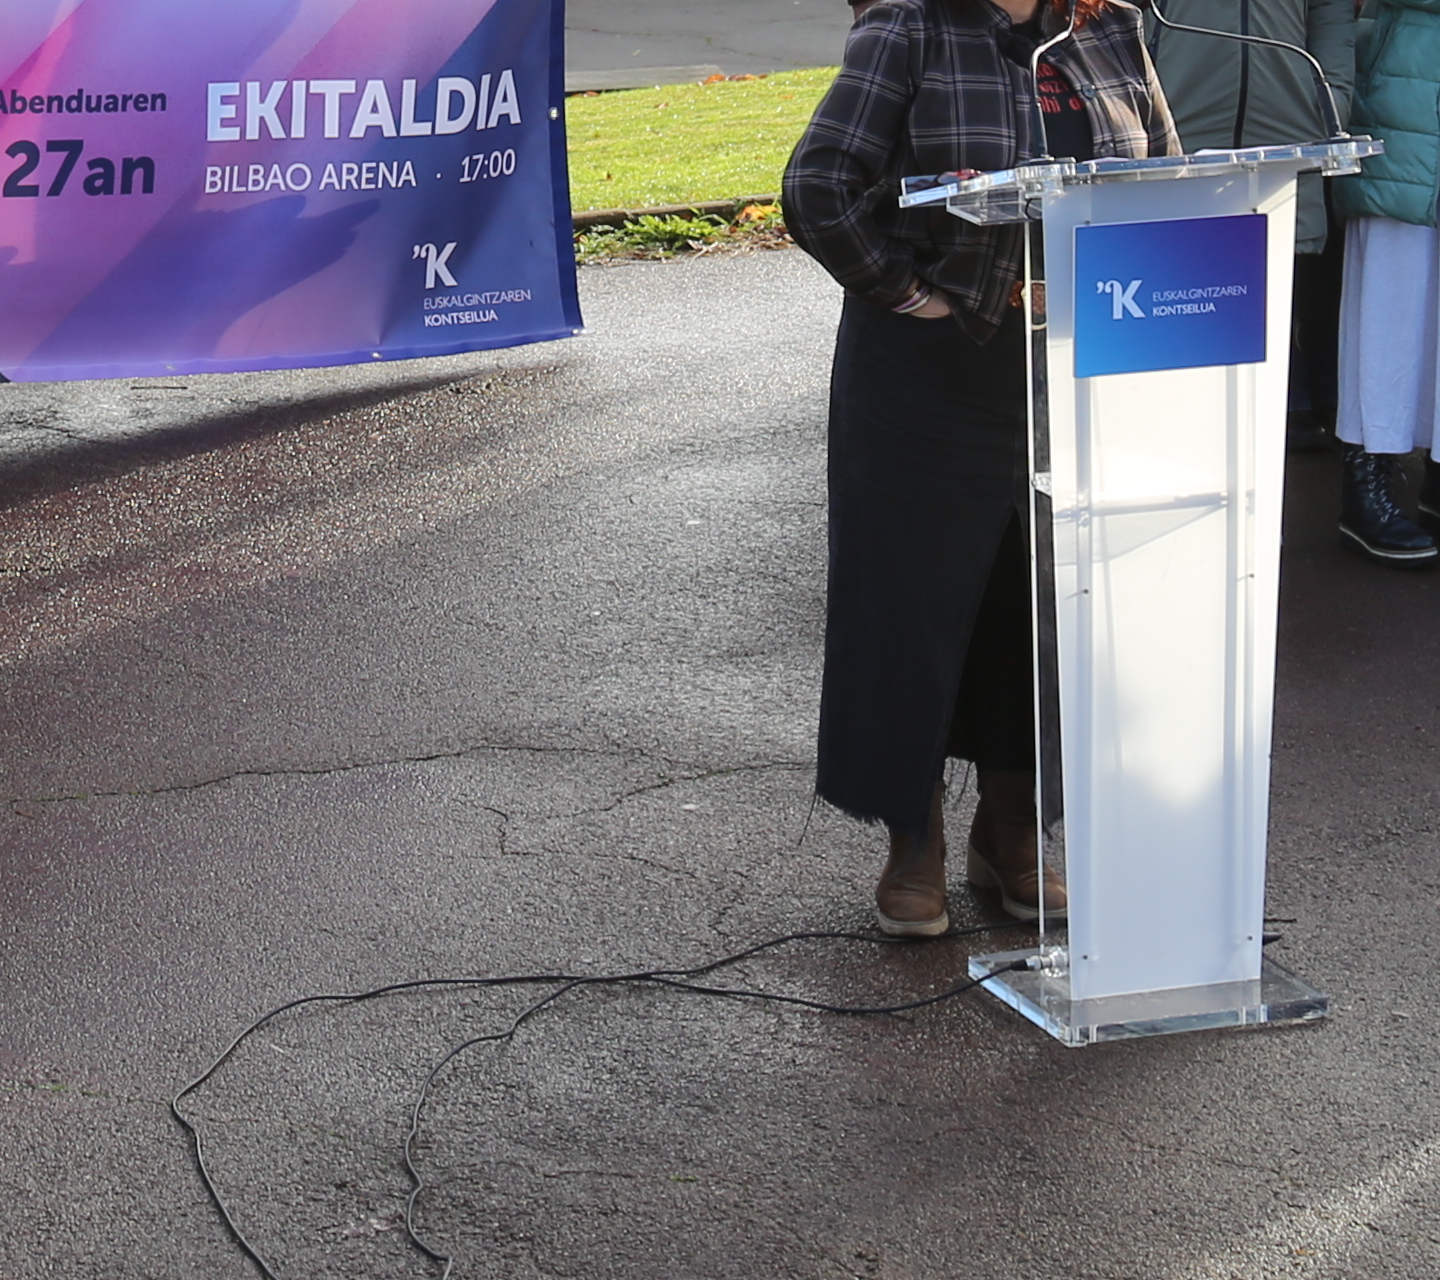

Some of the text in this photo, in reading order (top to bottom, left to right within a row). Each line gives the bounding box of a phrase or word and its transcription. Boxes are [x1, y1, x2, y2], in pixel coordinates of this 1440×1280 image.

[206, 68, 521, 142] EKITALDIA
[2, 139, 155, 198] 27an
[205, 148, 516, 193] BILBAO ARENA 17:00
[423, 289, 532, 310] EUSKALGINTZAREN
[1152, 285, 1248, 303] EUSKALGINTZAREN
[424, 309, 498, 327] KONTSEILUA
[1152, 302, 1216, 318] KONTSEILUA
